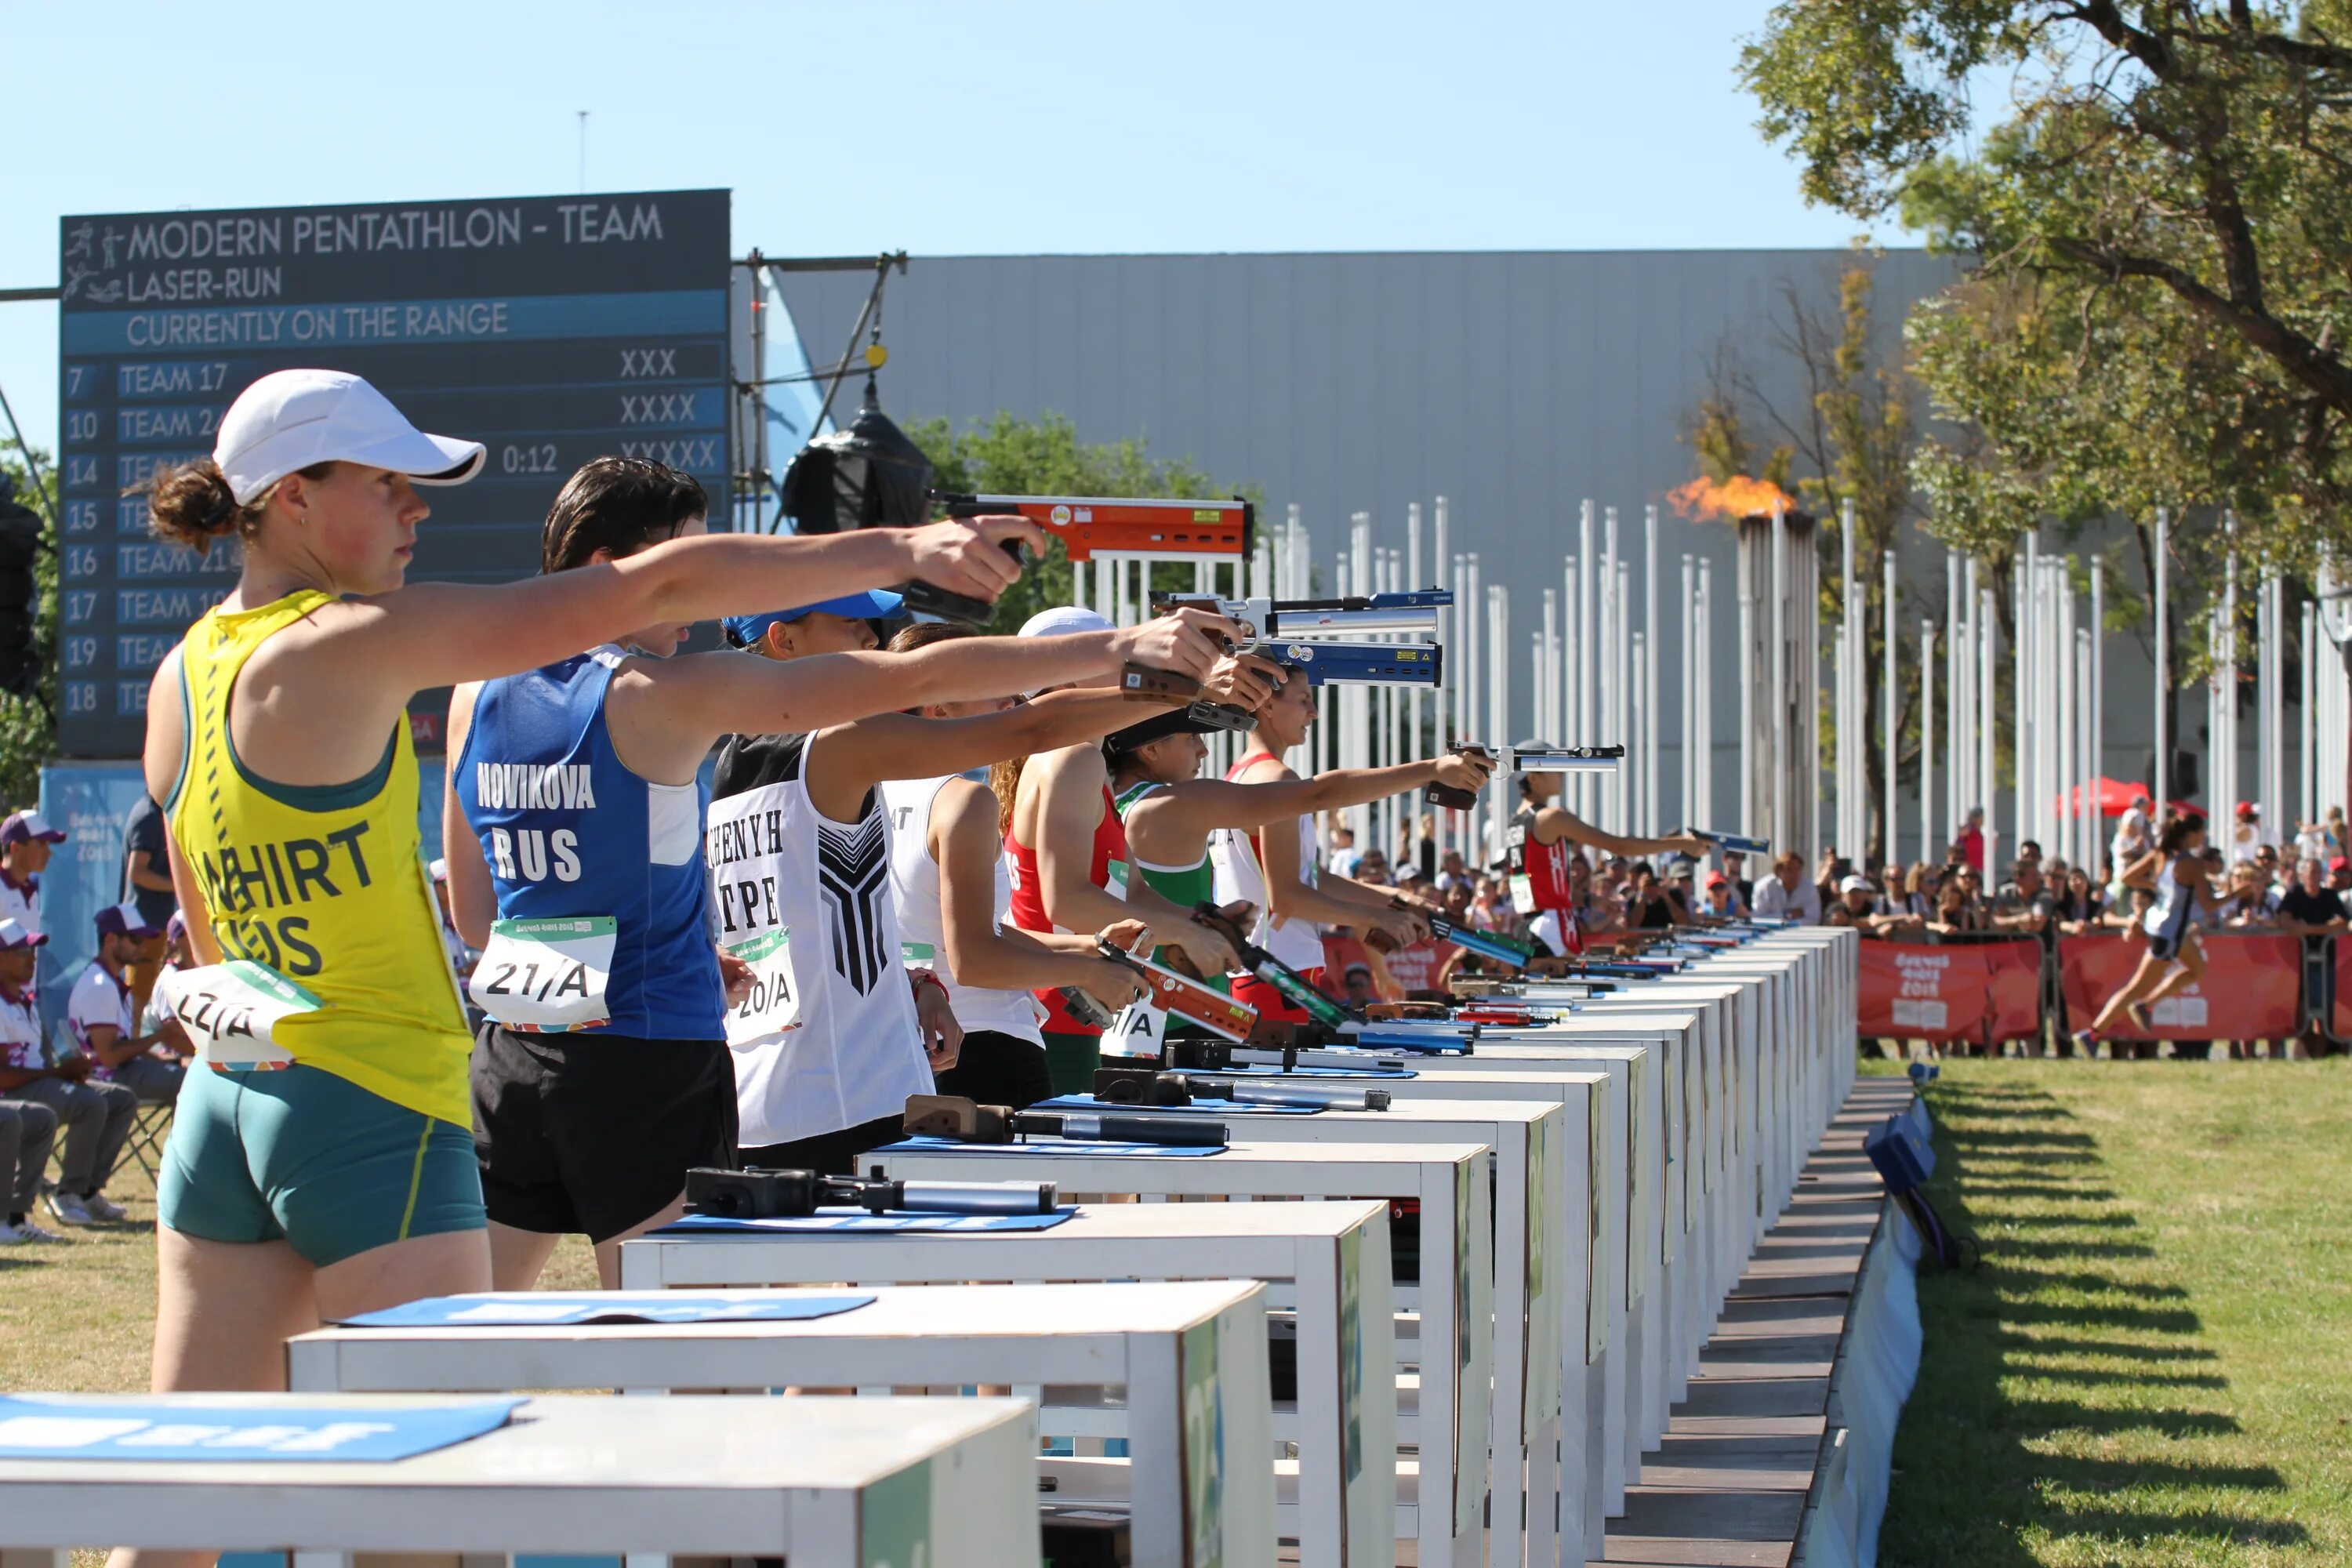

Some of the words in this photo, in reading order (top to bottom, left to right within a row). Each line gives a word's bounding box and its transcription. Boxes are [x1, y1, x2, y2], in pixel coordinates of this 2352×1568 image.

[126, 216, 281, 260] MODERN
[293, 208, 521, 254] PENTATHLON
[557, 203, 663, 244] TEAM
[128, 267, 281, 303] LASER-RUN
[127, 310, 285, 346] CURRENTLY
[292, 309, 336, 340] ON
[343, 306, 398, 339] THE
[405, 303, 508, 336] RANGE
[69, 368, 83, 396] 7
[120, 365, 192, 393] TEAM
[200, 362, 228, 390] 17
[620, 348, 677, 377] XXX
[69, 412, 97, 441] 10
[120, 409, 192, 438] TEAM
[620, 394, 695, 423] XXXX
[69, 457, 98, 485] 14
[503, 443, 557, 474] 0:12
[69, 502, 97, 531] 15
[69, 547, 97, 575] 16
[120, 545, 191, 574] TEAM
[69, 592, 97, 621] 17
[120, 590, 191, 619] TEAM
[69, 637, 97, 666] 19
[69, 684, 97, 713] 18
[477, 762, 596, 811] NOVIKOVA
[492, 827, 582, 882] RUS
[719, 877, 779, 932] TPE
[486, 958, 588, 1002] 21/A
